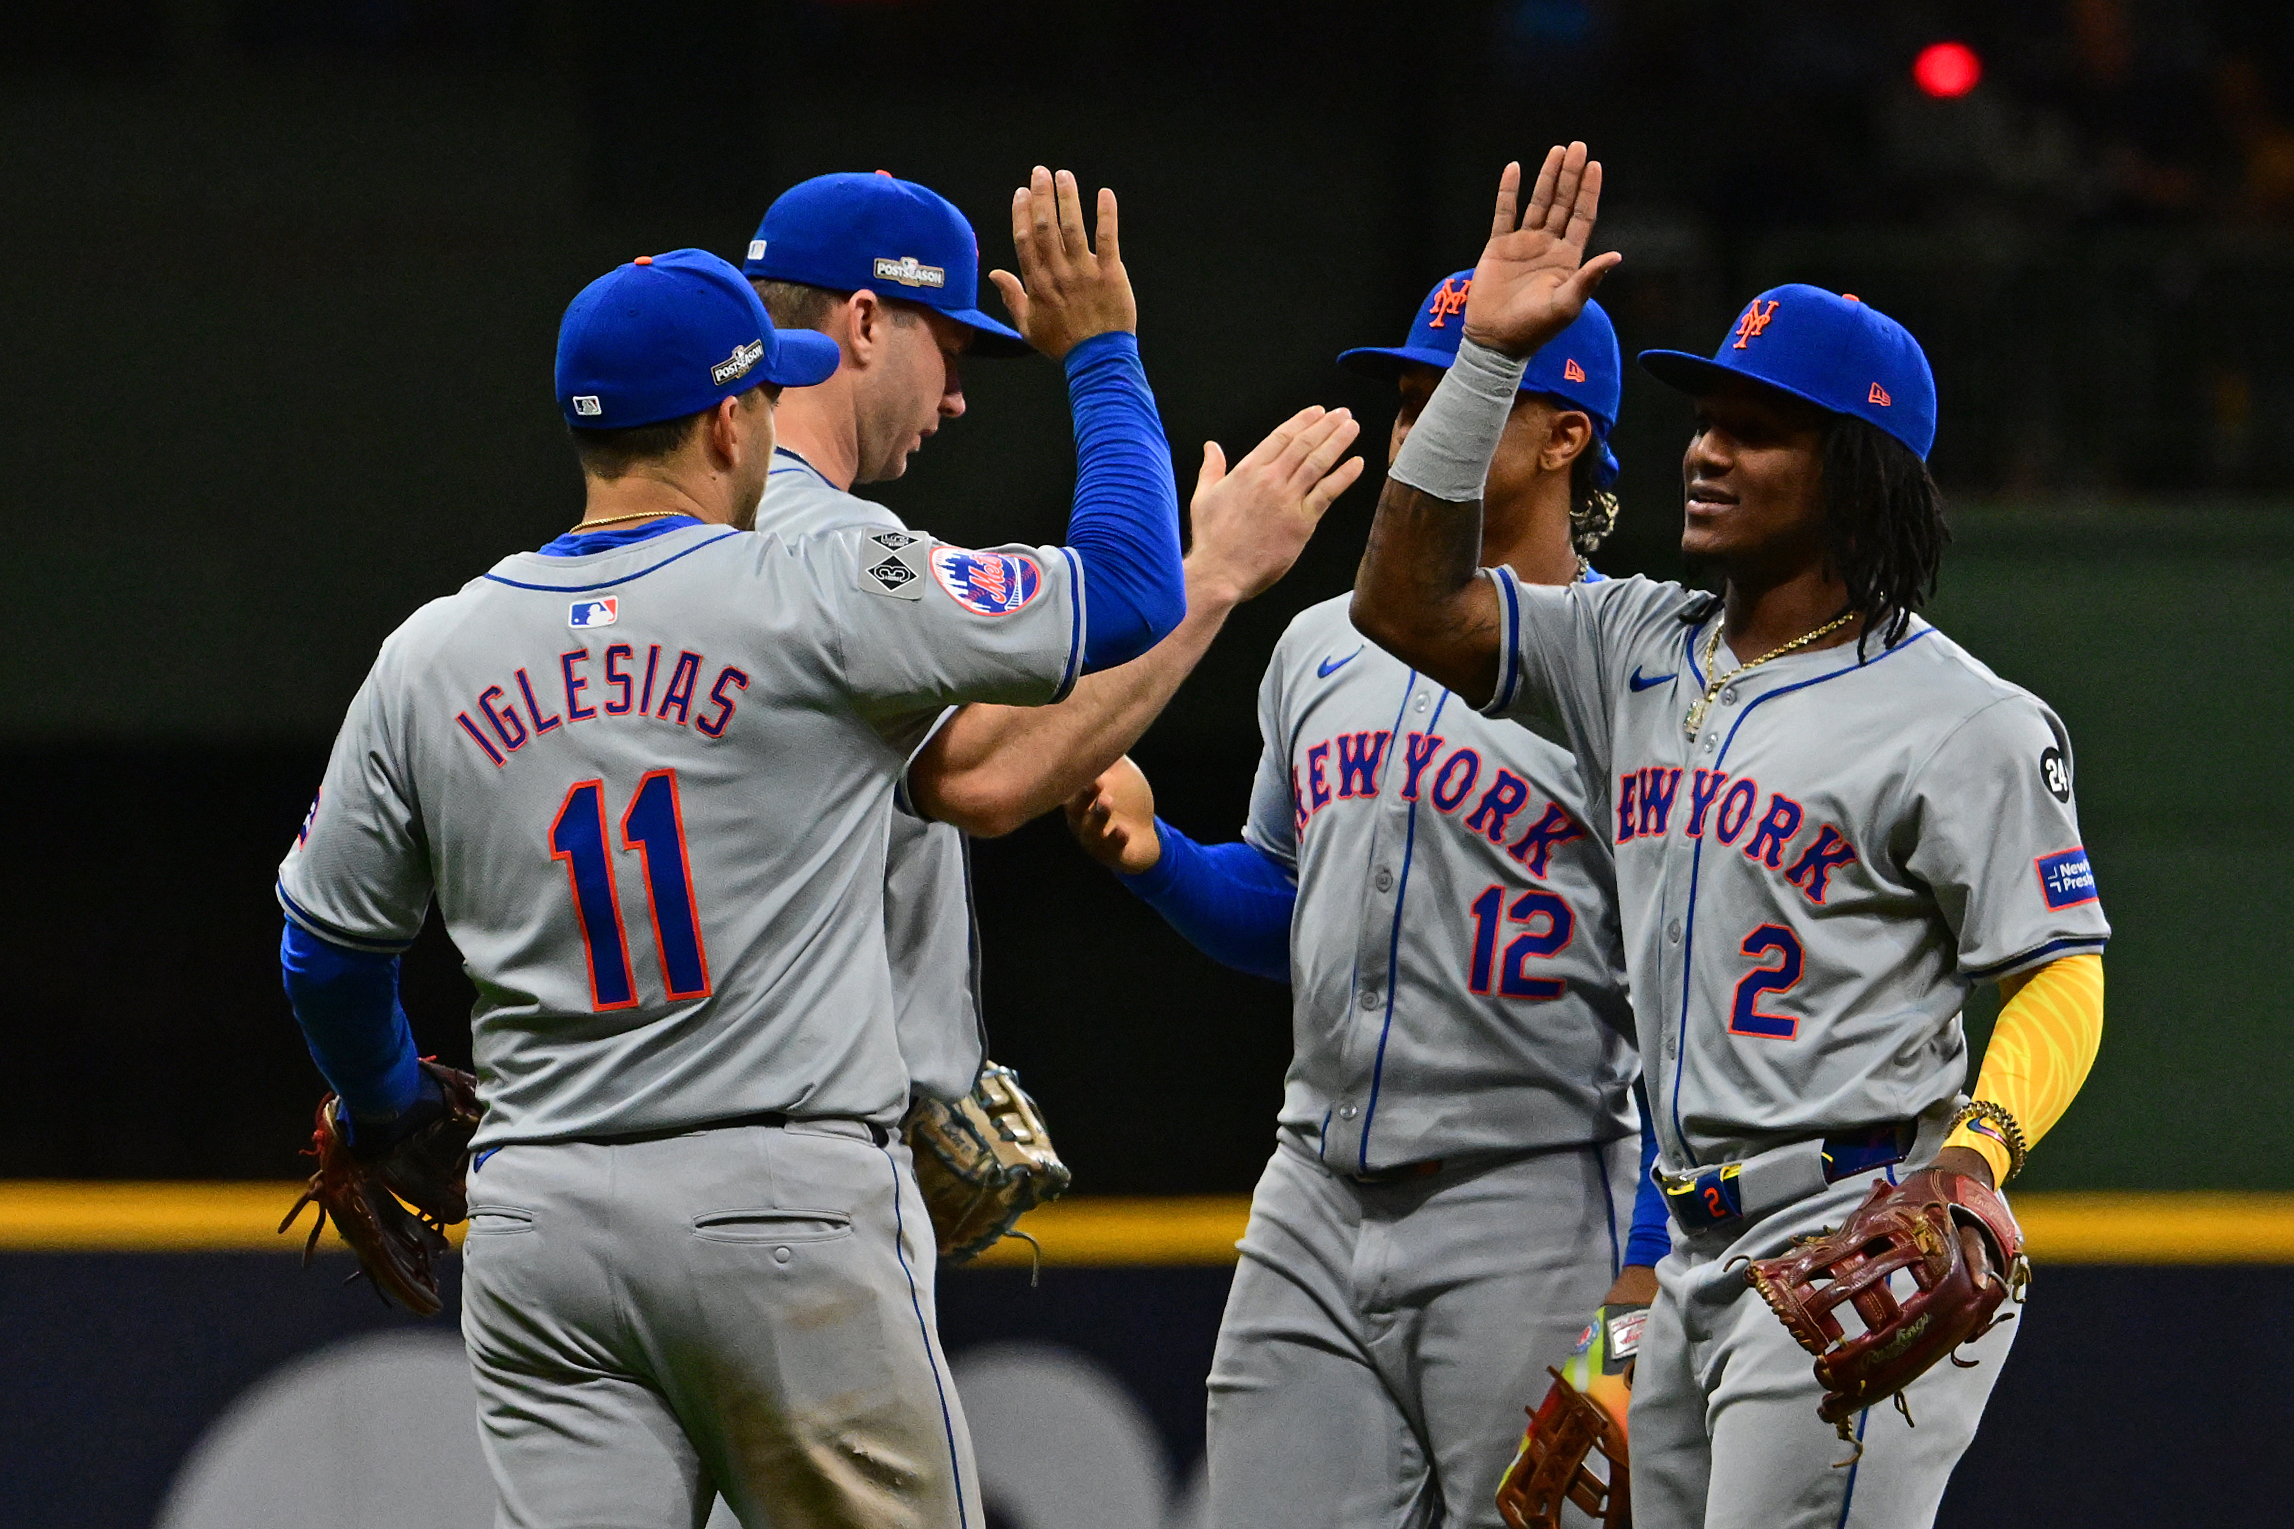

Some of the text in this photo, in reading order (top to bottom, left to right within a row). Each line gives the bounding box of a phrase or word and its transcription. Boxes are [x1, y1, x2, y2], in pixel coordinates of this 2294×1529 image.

[877, 261, 942, 284] POSTSEASON
[714, 345, 763, 382] POSTSEASON
[968, 553, 1007, 604] Met
[455, 643, 750, 768] IGLESIAS
[1400, 731, 1587, 880] YORK
[2045, 757, 2068, 792] 24
[548, 767, 712, 1012] 11
[1685, 767, 1858, 904] YORK
[1468, 884, 1575, 1000] 12
[1728, 921, 1805, 1041] 2
[1704, 1187, 1726, 1218] 2
